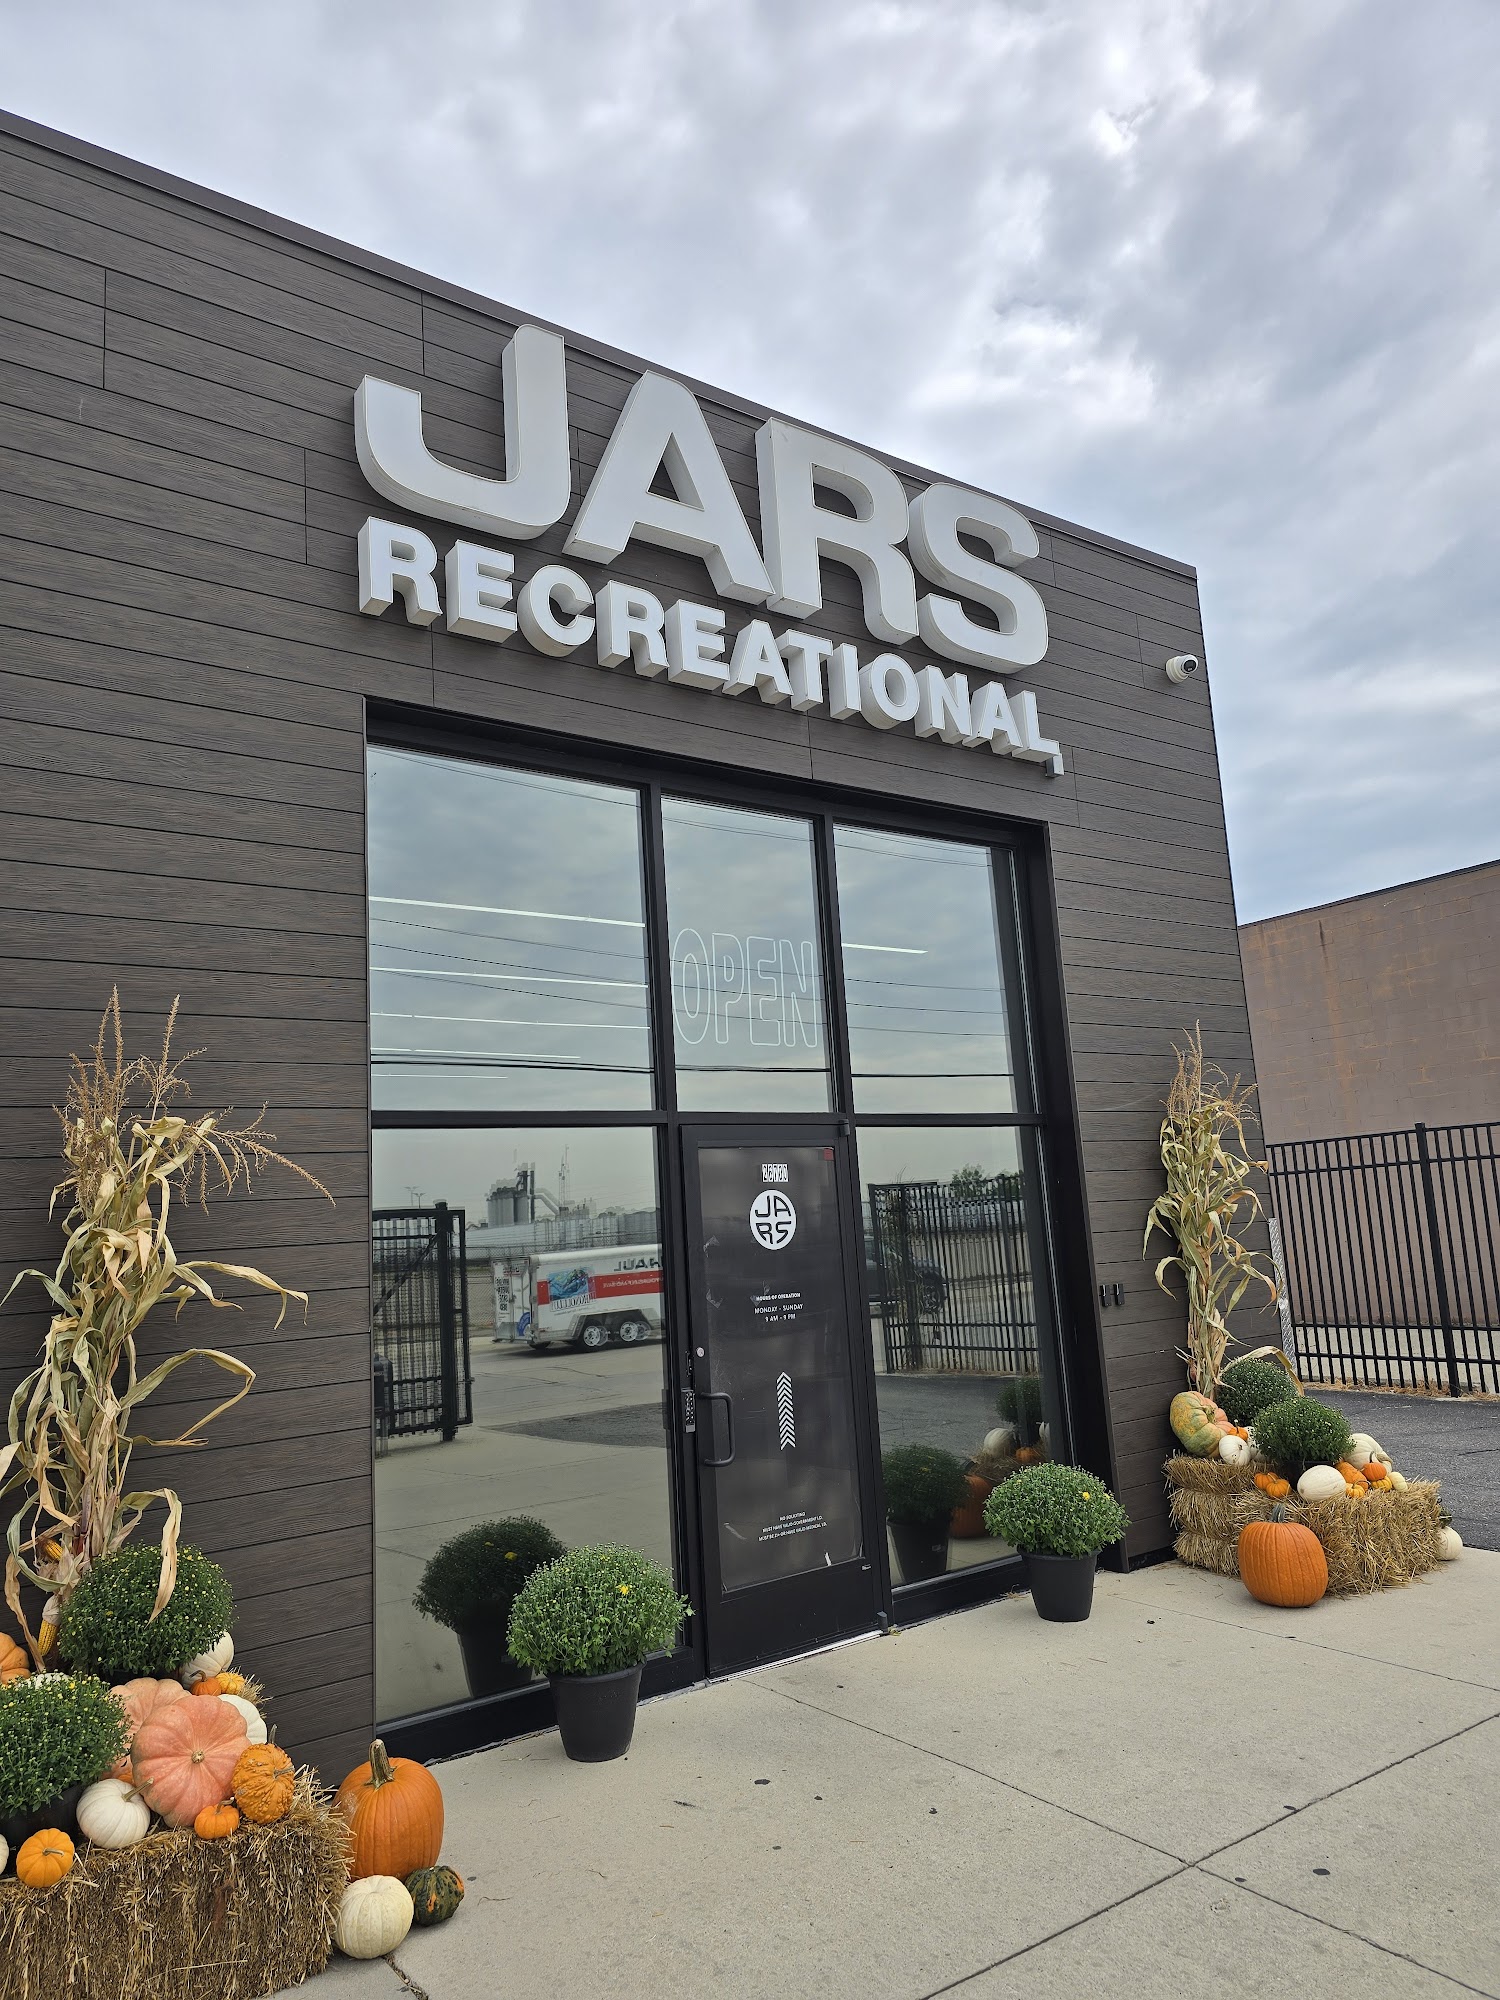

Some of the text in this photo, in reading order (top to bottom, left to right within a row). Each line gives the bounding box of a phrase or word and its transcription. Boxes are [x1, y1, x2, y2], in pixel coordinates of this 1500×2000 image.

[354, 324, 1048, 674] JARS
[358, 515, 1061, 763] RECREATIONAL
[671, 928, 817, 1047] OPEN
[754, 1305, 778, 1314] MONDAY
[783, 1303, 803, 1311] SUNDAY
